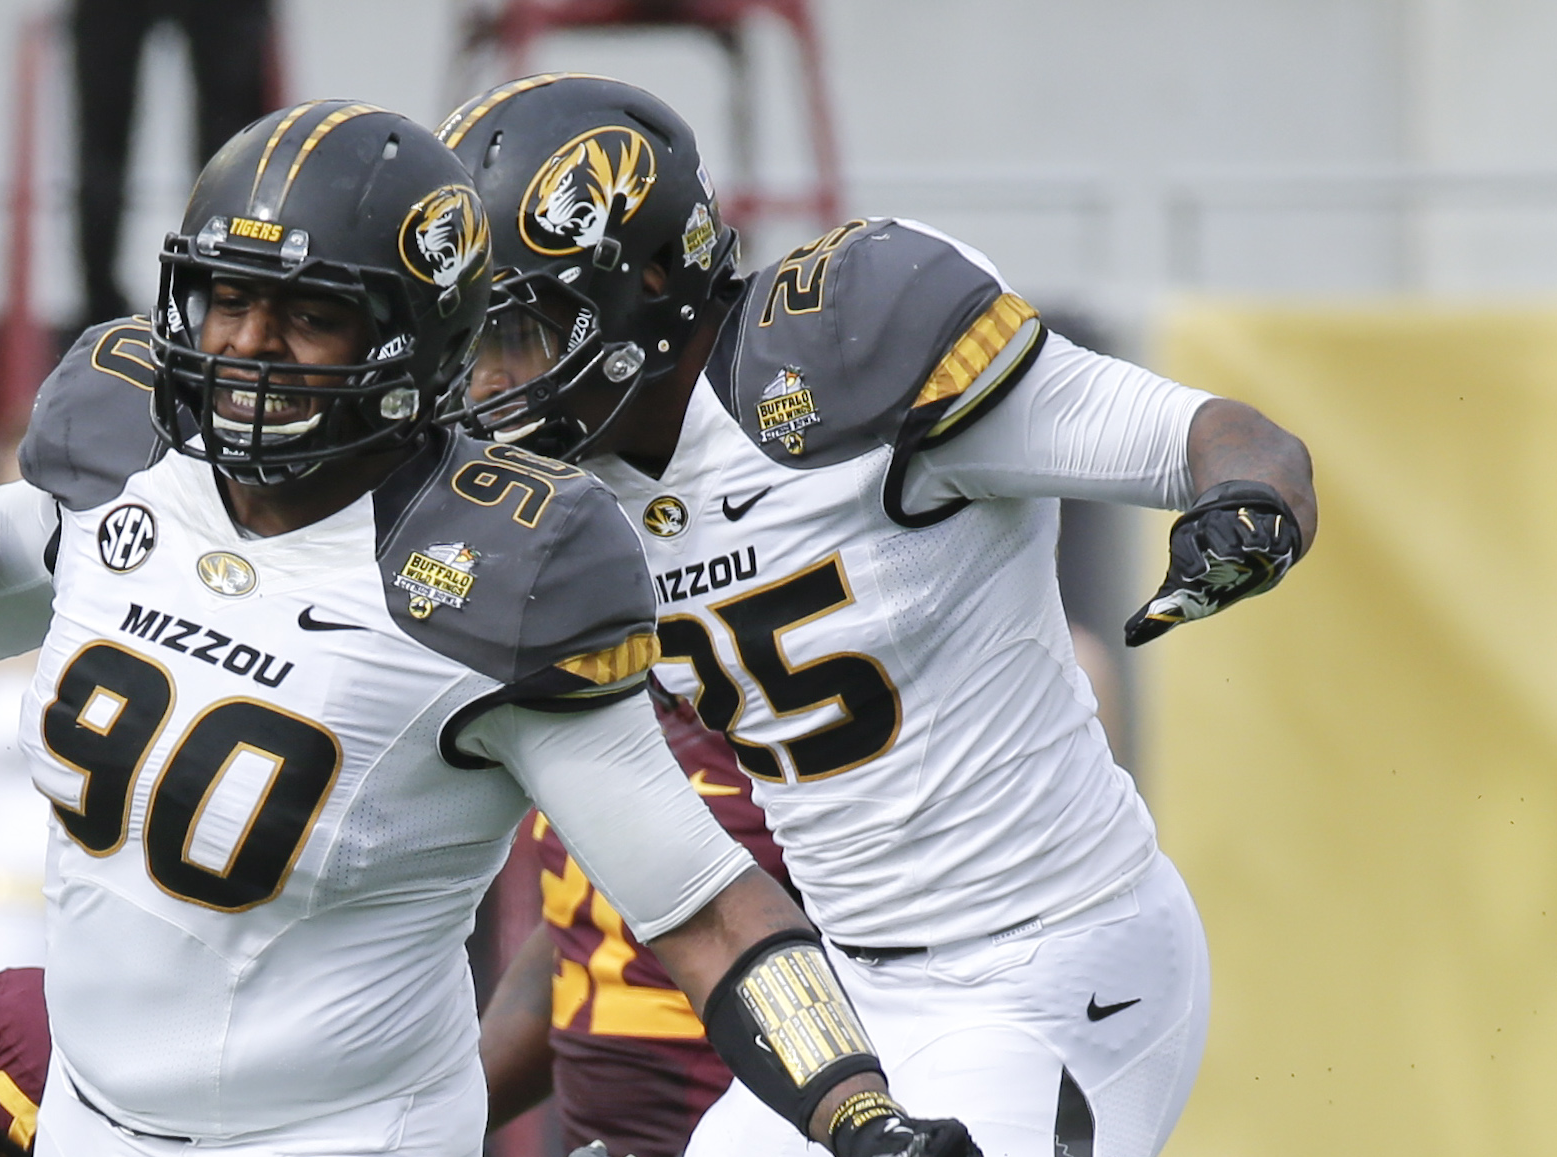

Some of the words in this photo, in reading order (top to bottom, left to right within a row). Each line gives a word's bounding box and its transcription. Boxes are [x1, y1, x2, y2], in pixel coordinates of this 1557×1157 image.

[229, 217, 284, 242] TIGERS
[759, 390, 810, 419] BUFFALO
[451, 443, 586, 530] 90
[101, 505, 154, 569] SEC
[410, 554, 472, 589] BUFFALO
[656, 545, 757, 605] IZZOU
[119, 602, 295, 689] MIZZOU
[40, 638, 344, 914] 90
